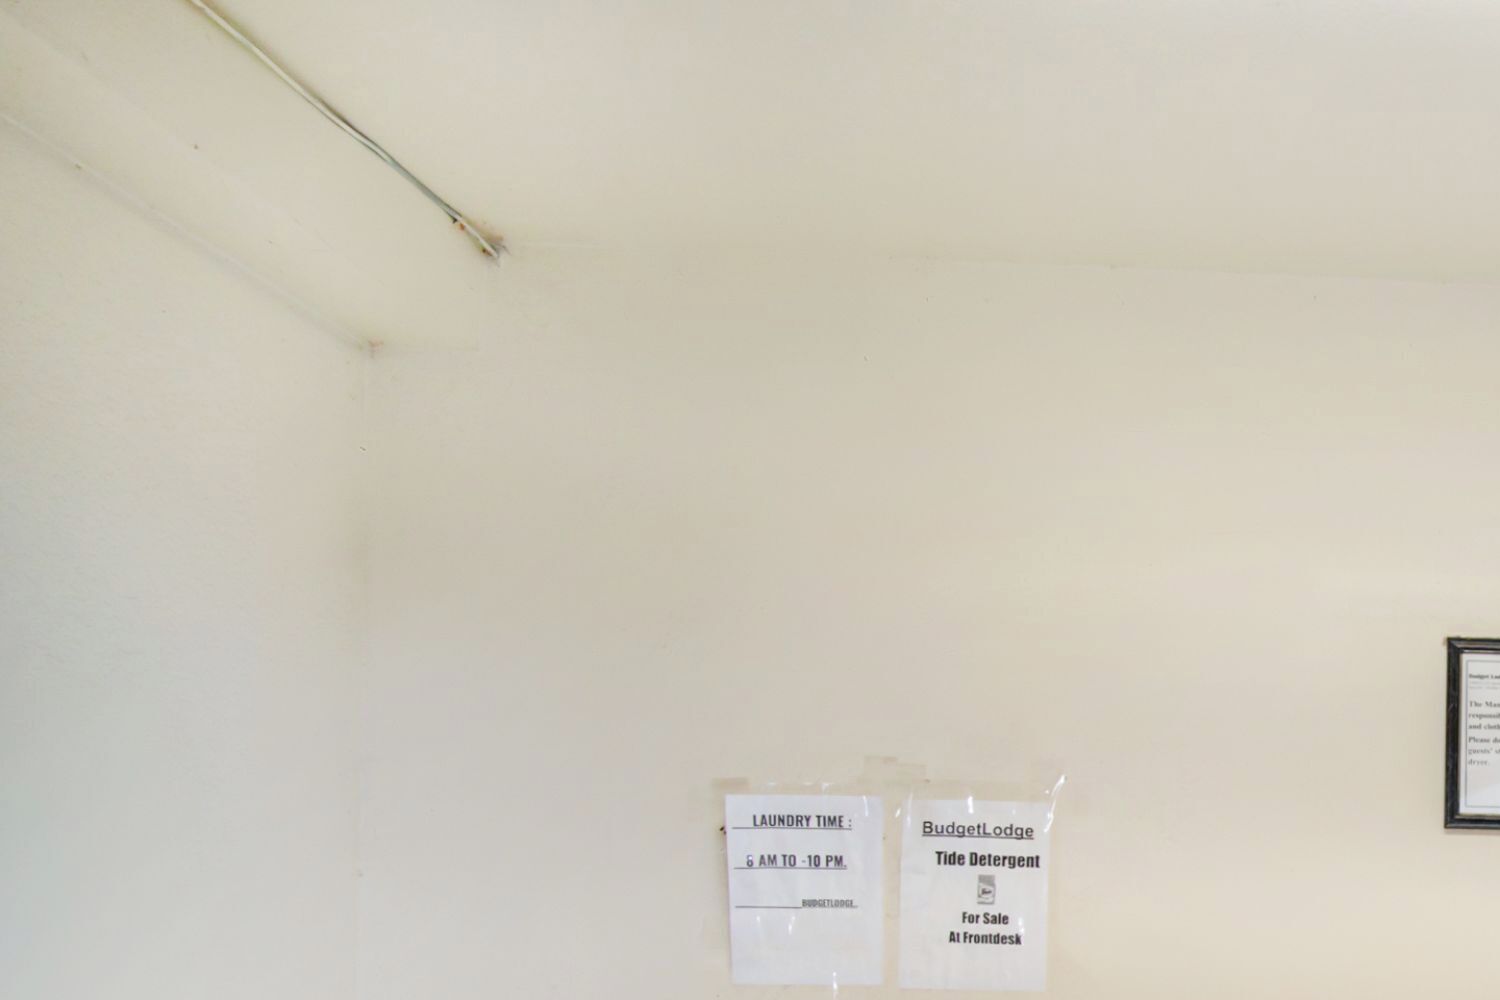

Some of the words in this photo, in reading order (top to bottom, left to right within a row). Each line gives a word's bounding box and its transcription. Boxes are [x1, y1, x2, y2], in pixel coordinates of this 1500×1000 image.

[752, 814, 811, 828] LAUNDRY
[815, 815, 844, 828] TIME
[922, 820, 1034, 840] BudgetLodge
[758, 854, 777, 867] AM
[781, 854, 797, 867] TO
[825, 854, 847, 868] PM.
[935, 851, 965, 866] Tide
[969, 852, 1041, 869] Detergent
[962, 911, 980, 924] For
[983, 912, 1009, 925] Sale
[949, 931, 960, 943] At
[963, 931, 1022, 945] Frontdesk
